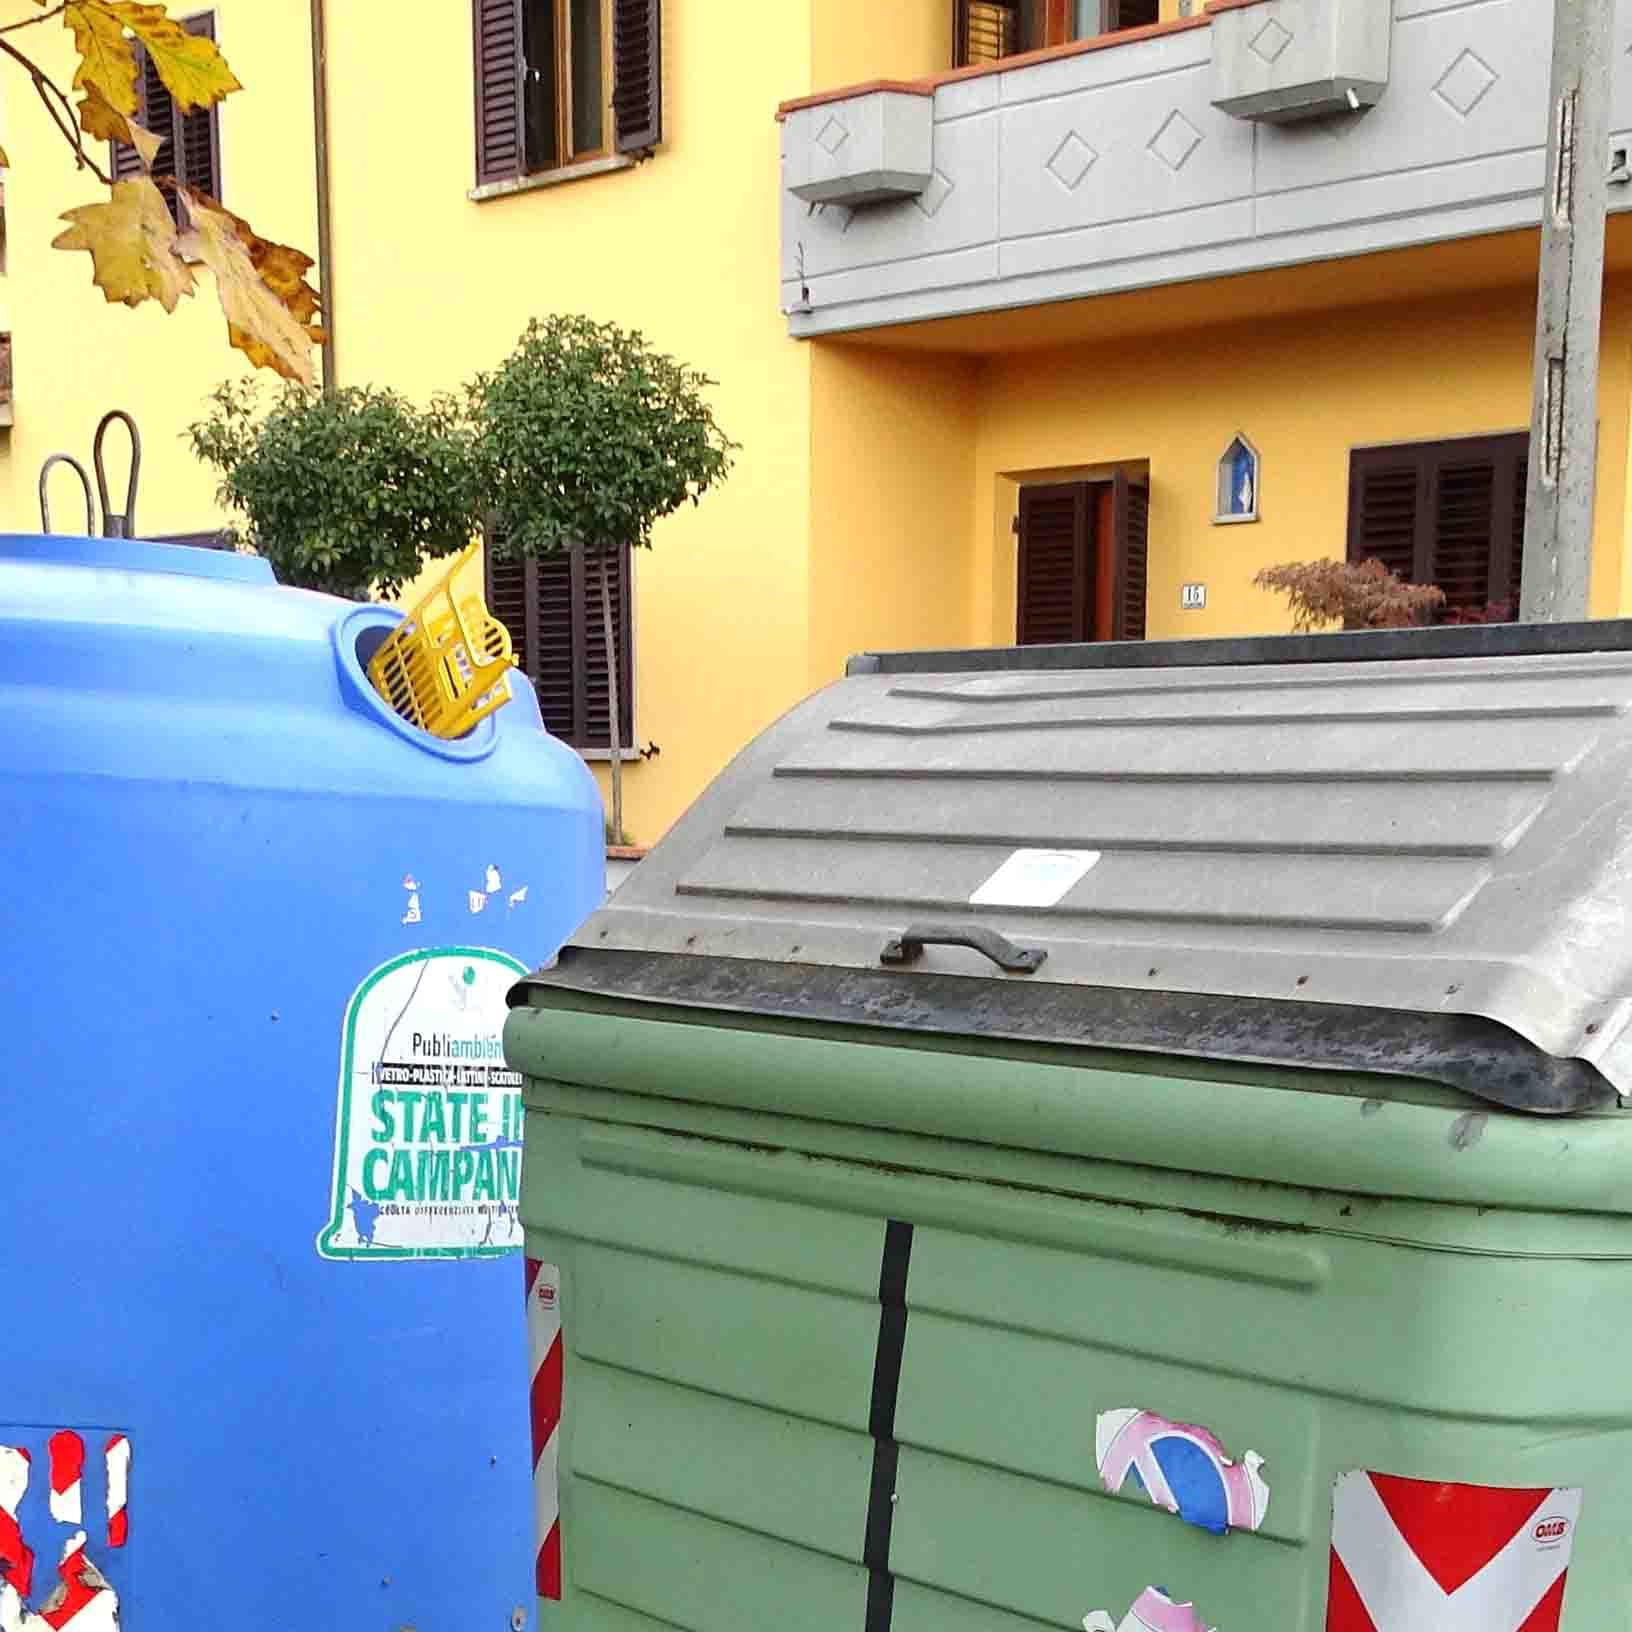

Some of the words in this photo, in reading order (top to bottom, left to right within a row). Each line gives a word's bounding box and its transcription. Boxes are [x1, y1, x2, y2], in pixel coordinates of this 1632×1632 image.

[412, 1032, 504, 1059] Publiambien
[371, 1091, 489, 1143] STATE
[363, 1149, 523, 1201] CAMPAN
